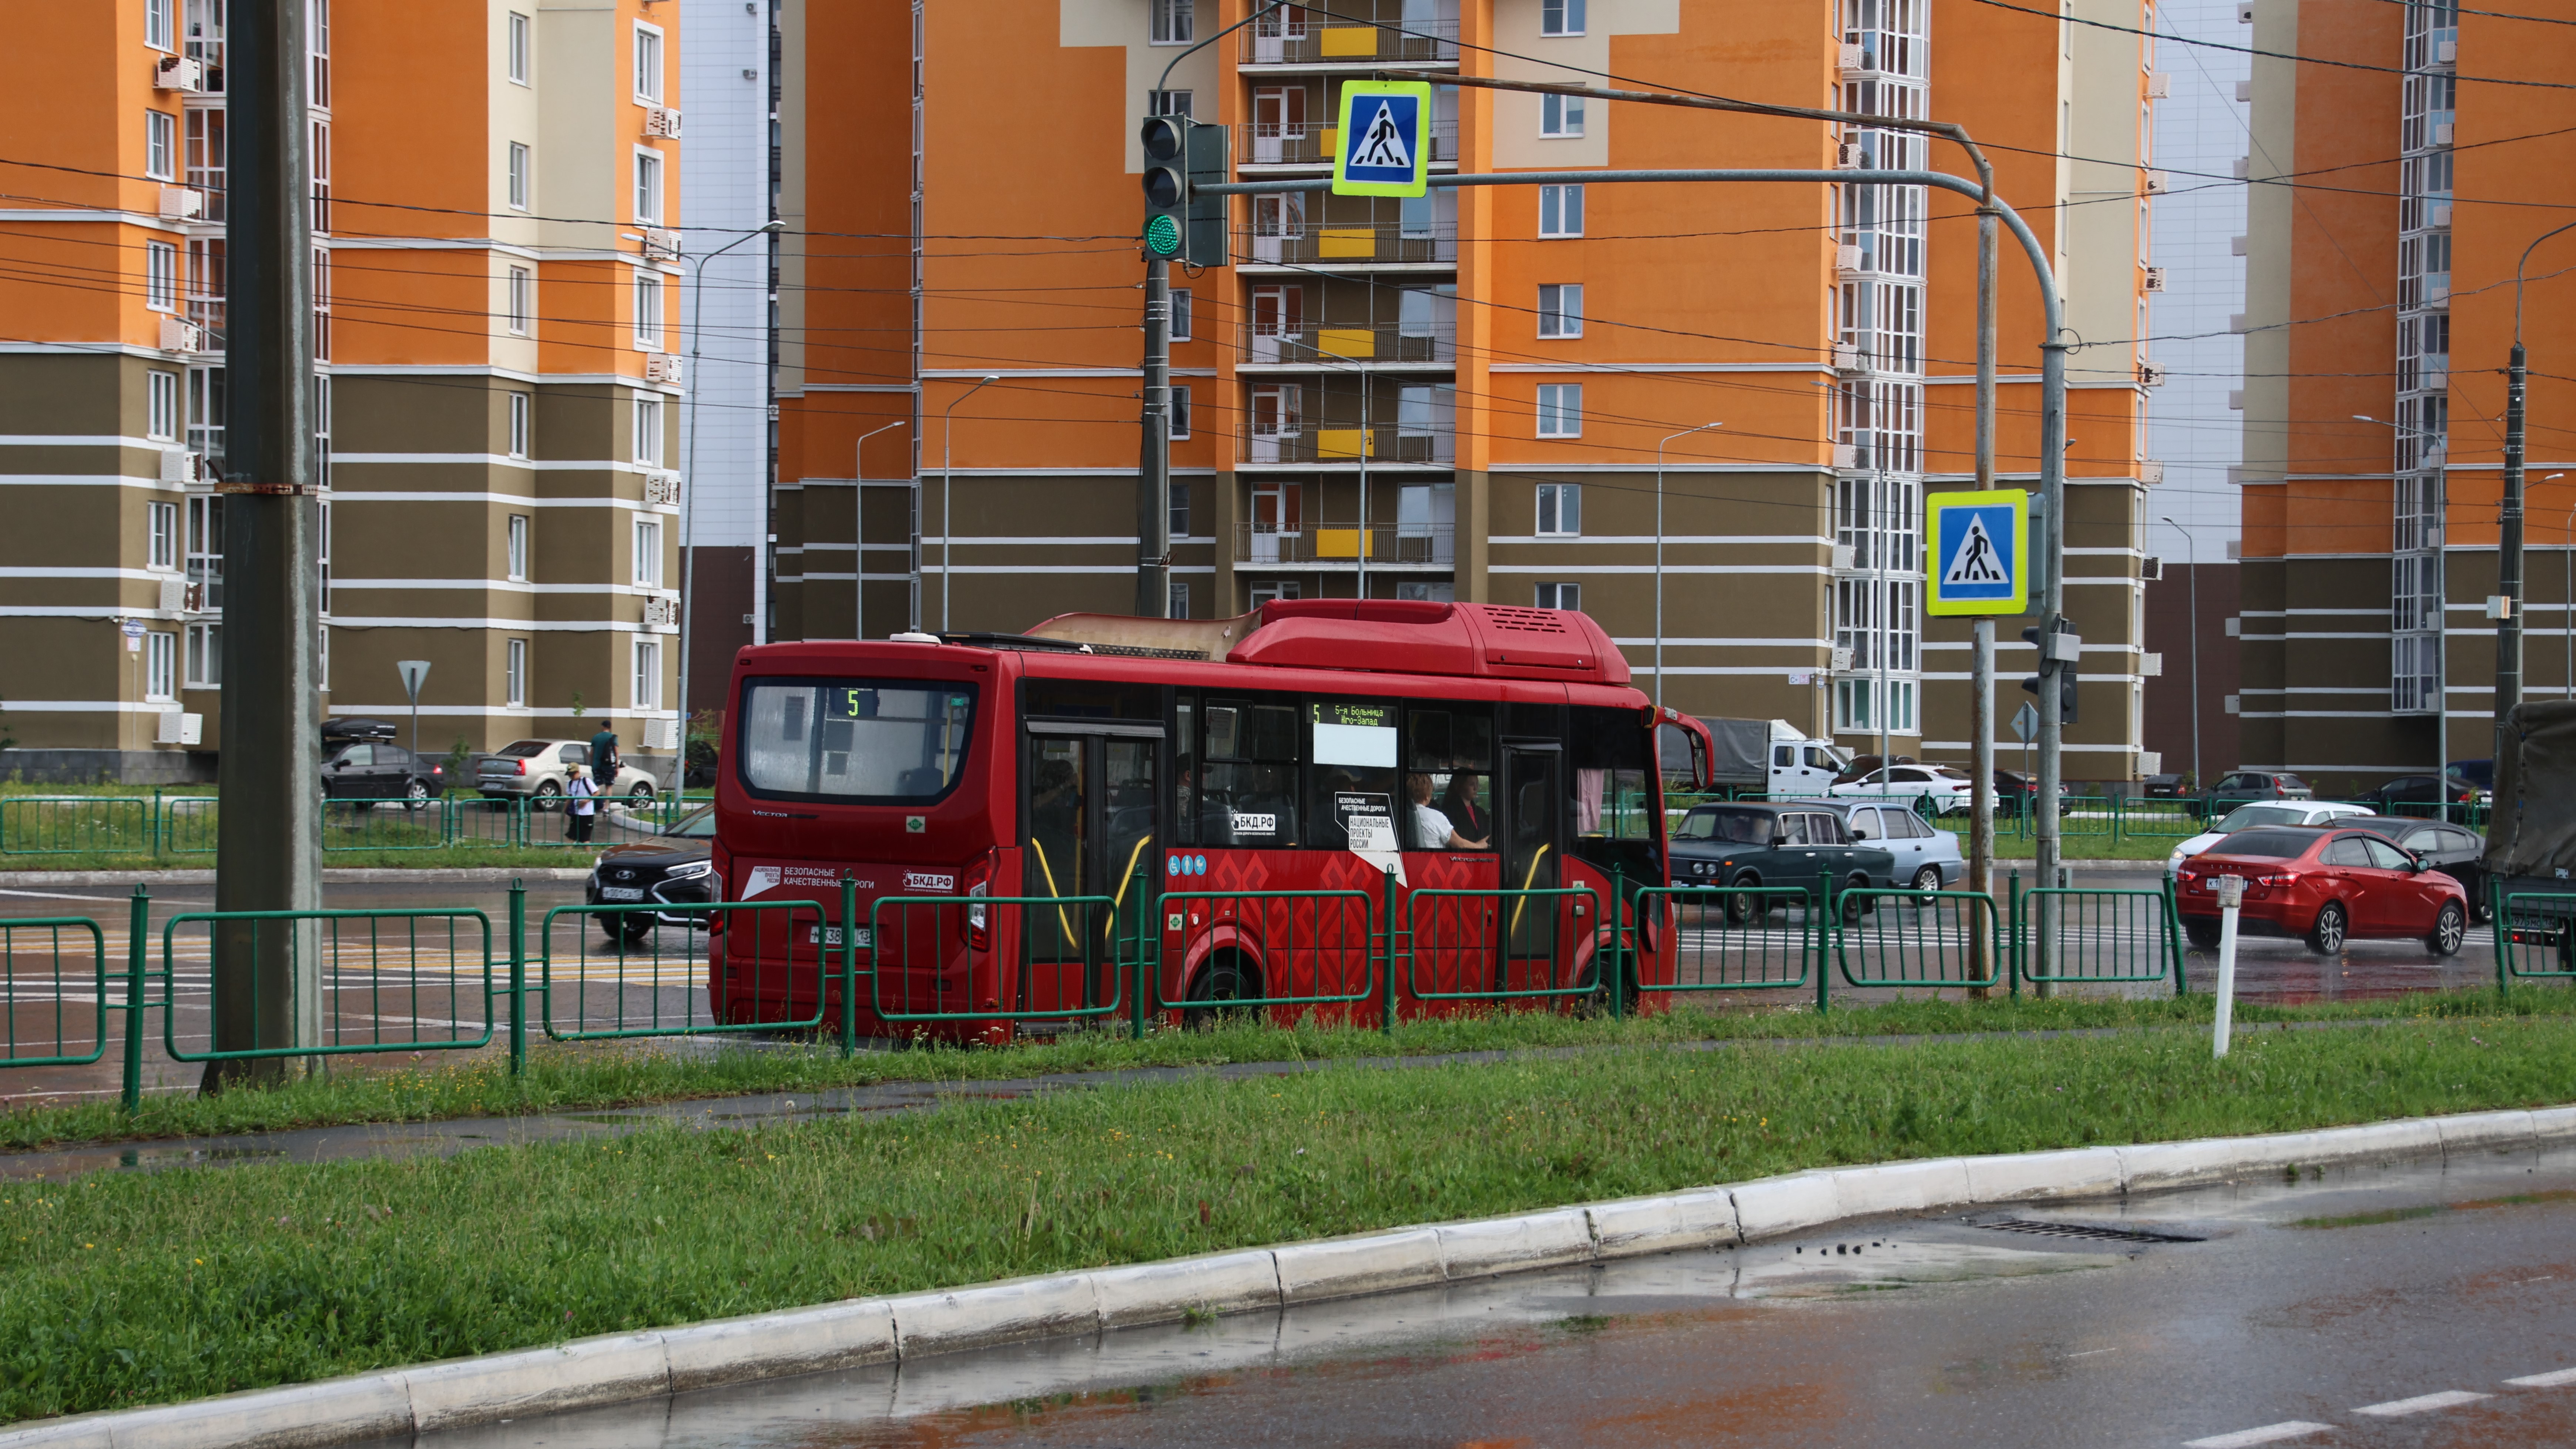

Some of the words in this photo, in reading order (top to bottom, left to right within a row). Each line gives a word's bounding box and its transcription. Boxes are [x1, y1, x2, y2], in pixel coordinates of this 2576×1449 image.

[848, 690, 858, 716] 5
[1314, 704, 1319, 724] 5
[1335, 705, 1348, 715] 5-я
[1351, 706, 1383, 717] Больница
[1341, 715, 1378, 726] Юго-Запад
[1241, 816, 1274, 829] БКД.РФ
[1350, 817, 1389, 828] НАЦИОНАЛЬНЫЕ
[1350, 828, 1372, 838] ПРОЕКТЫ
[1350, 839, 1368, 848] РОССИИ
[785, 867, 835, 876] БЕЗОПАСНЫЕ
[784, 877, 842, 887] КАЧЕСТВЕННЫЕ
[855, 881, 874, 889] РОГИ
[913, 875, 951, 887] БКД.РФ
